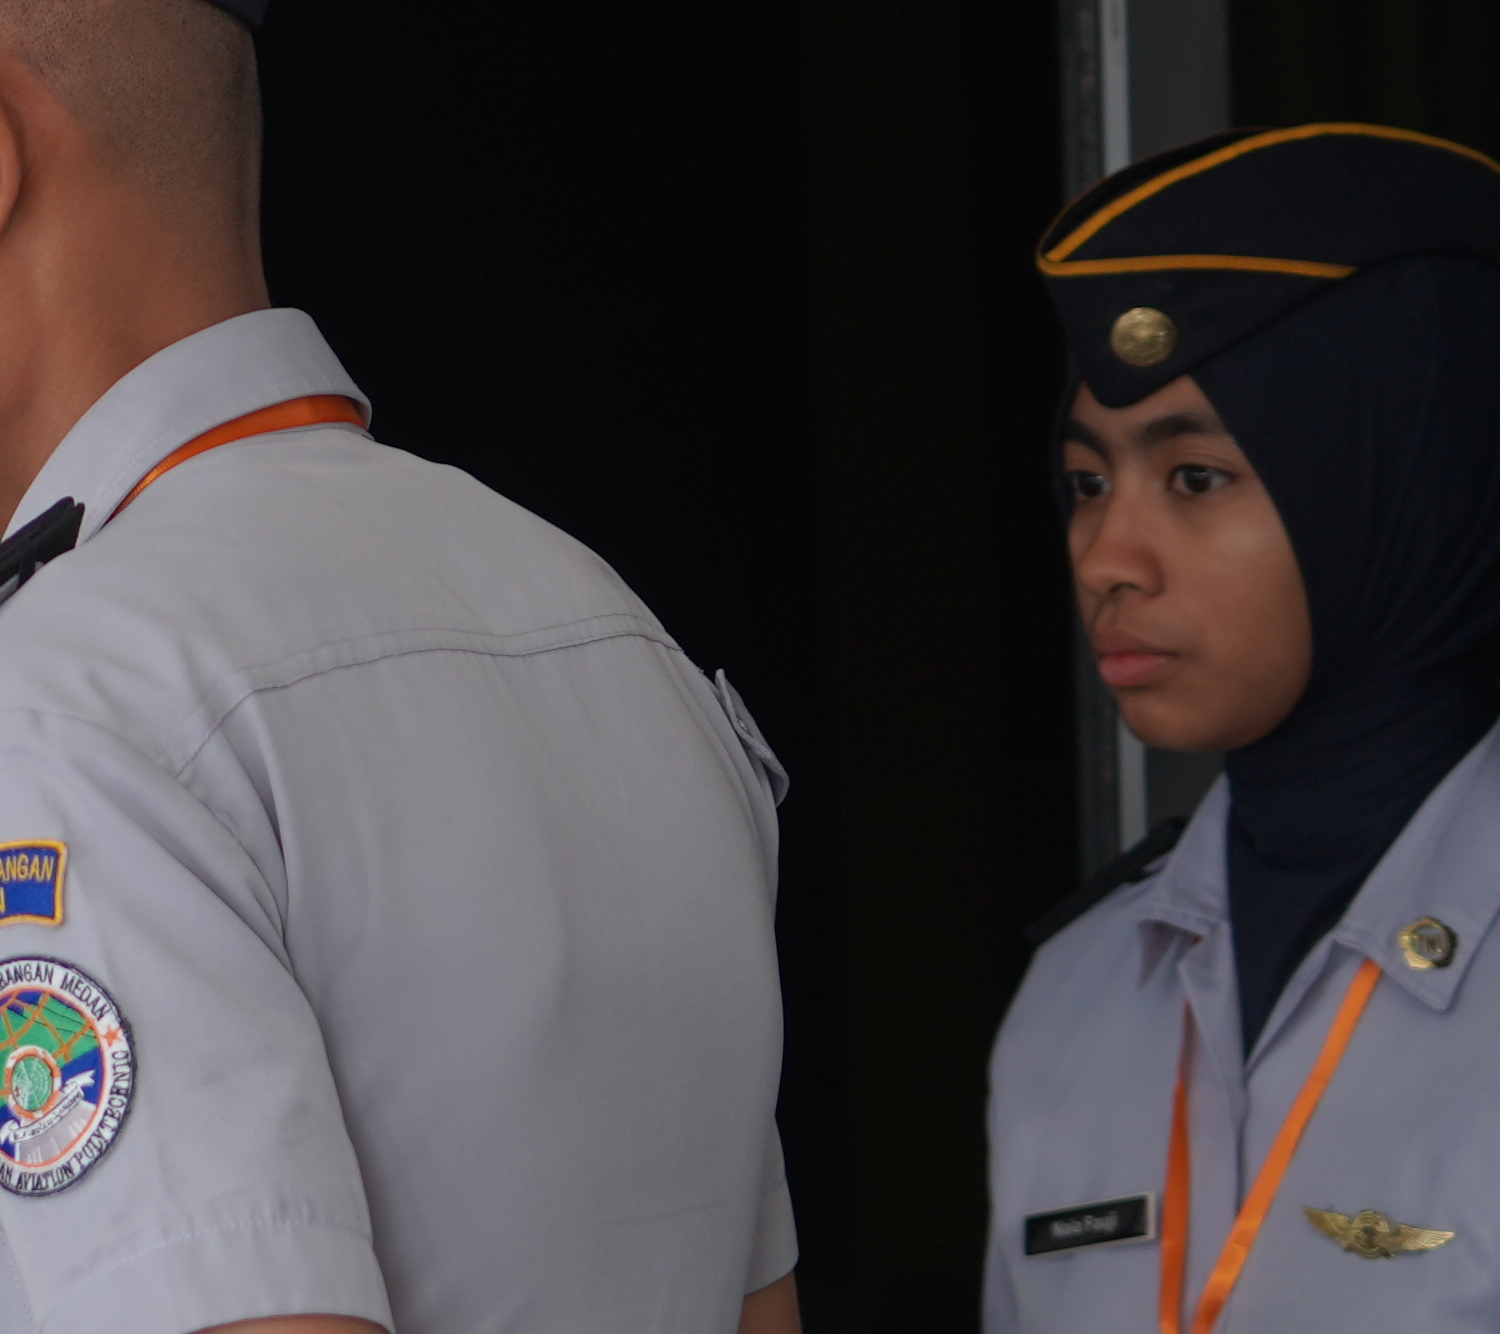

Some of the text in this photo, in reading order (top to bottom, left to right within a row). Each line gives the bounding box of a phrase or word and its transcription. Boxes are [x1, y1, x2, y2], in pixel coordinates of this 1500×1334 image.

[59, 971, 113, 1021] MEDAN
[15, 1160, 76, 1192] AVIATION
[71, 1049, 132, 1168] POLYTECHNIC
